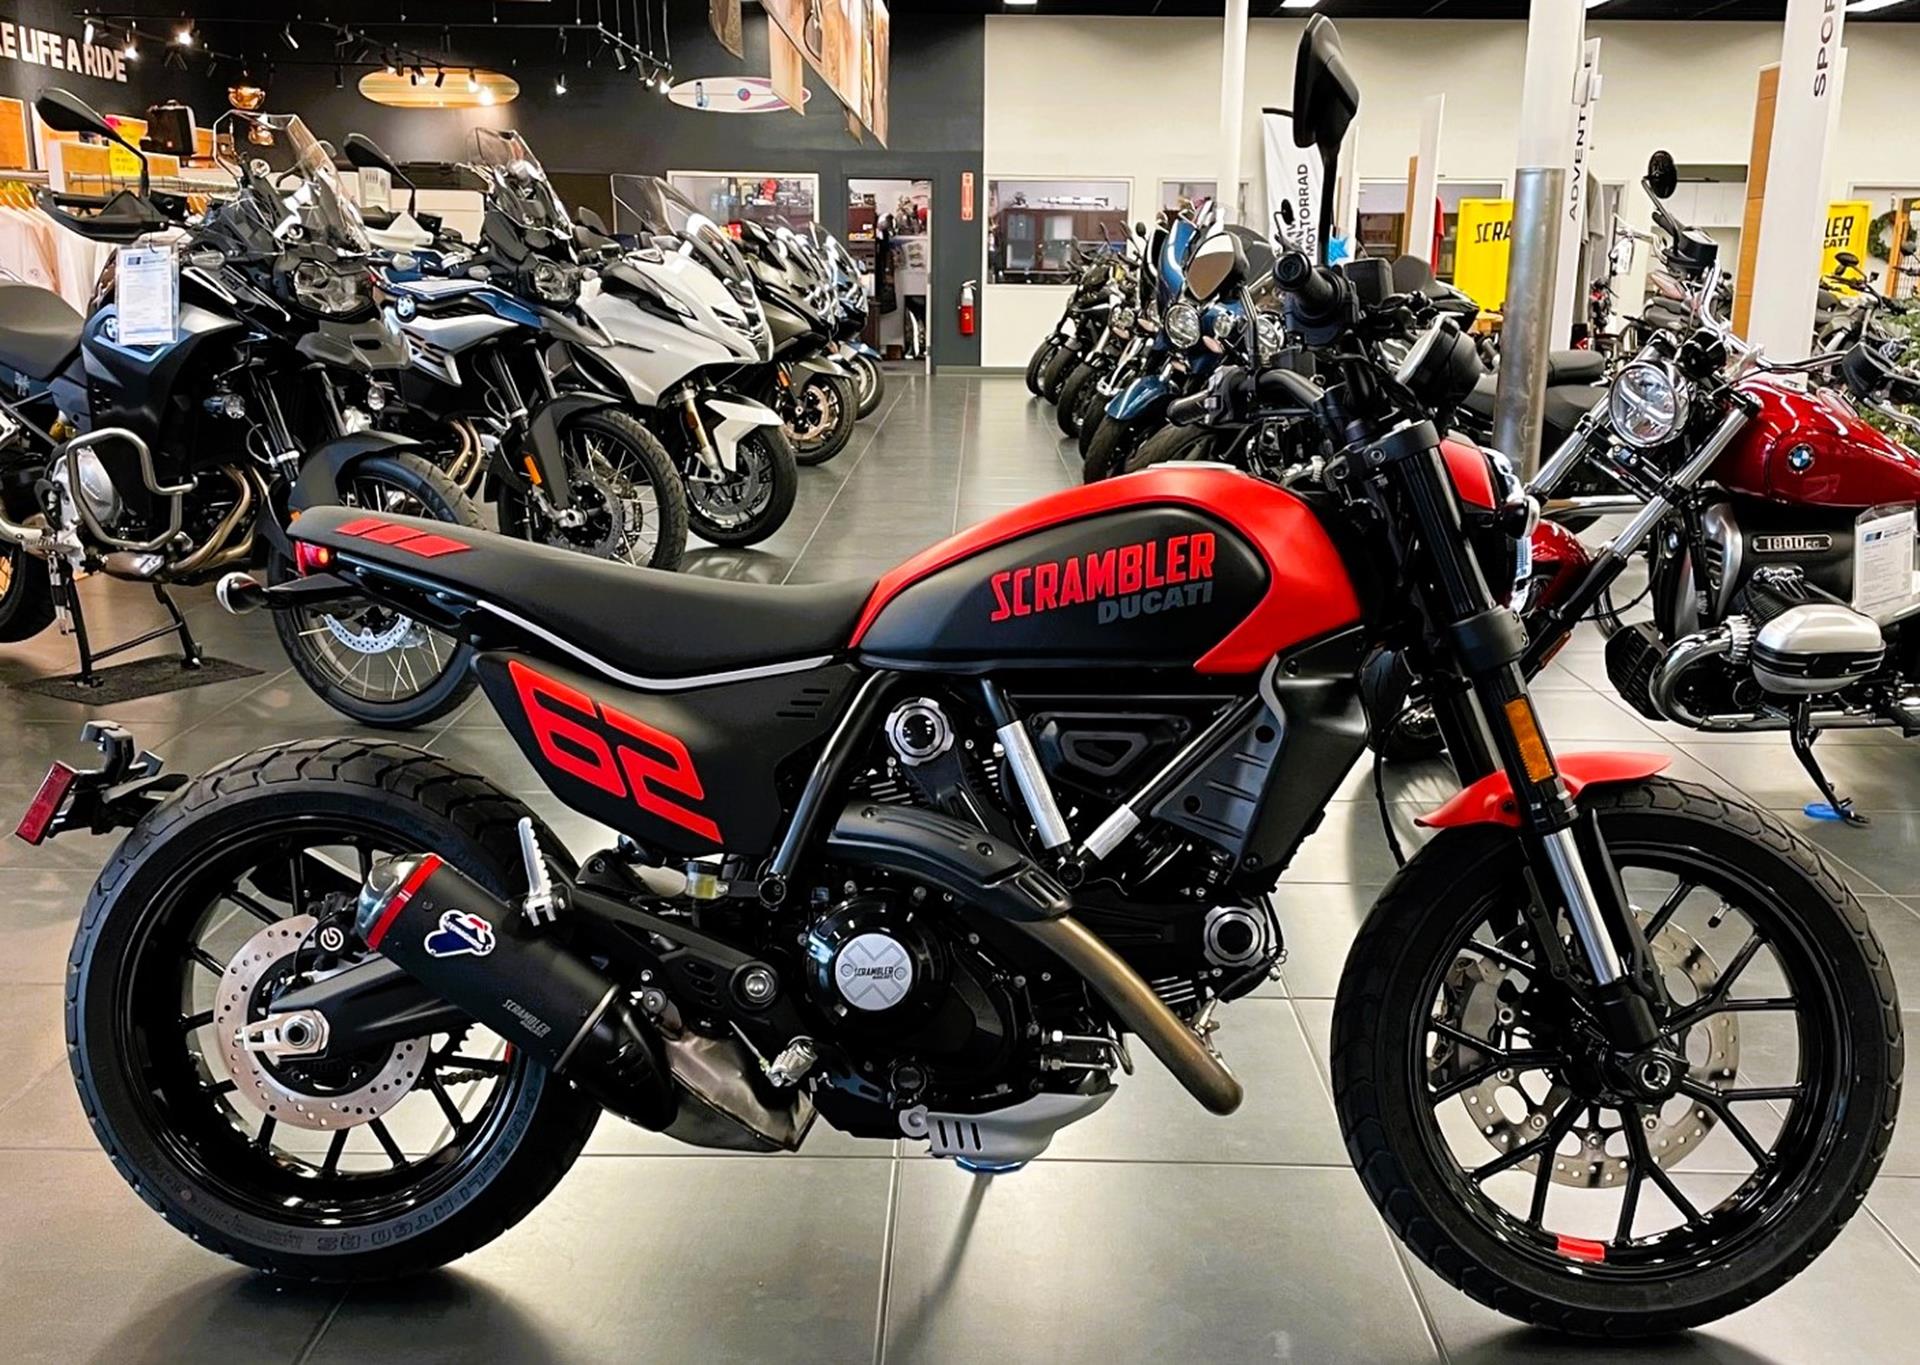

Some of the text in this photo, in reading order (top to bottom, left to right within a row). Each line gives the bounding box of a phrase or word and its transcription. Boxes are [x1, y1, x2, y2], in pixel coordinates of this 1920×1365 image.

[0, 22, 127, 83] E LIFE A RIDE
[1474, 220, 1512, 244] SCRA
[1823, 237, 1850, 249] CATI
[1825, 216, 1854, 238] LER
[991, 532, 1216, 622] SCRAMBLER
[1098, 580, 1214, 624] DUCATI
[508, 660, 724, 845] 62
[502, 999, 551, 1035] SCRAMBLER
